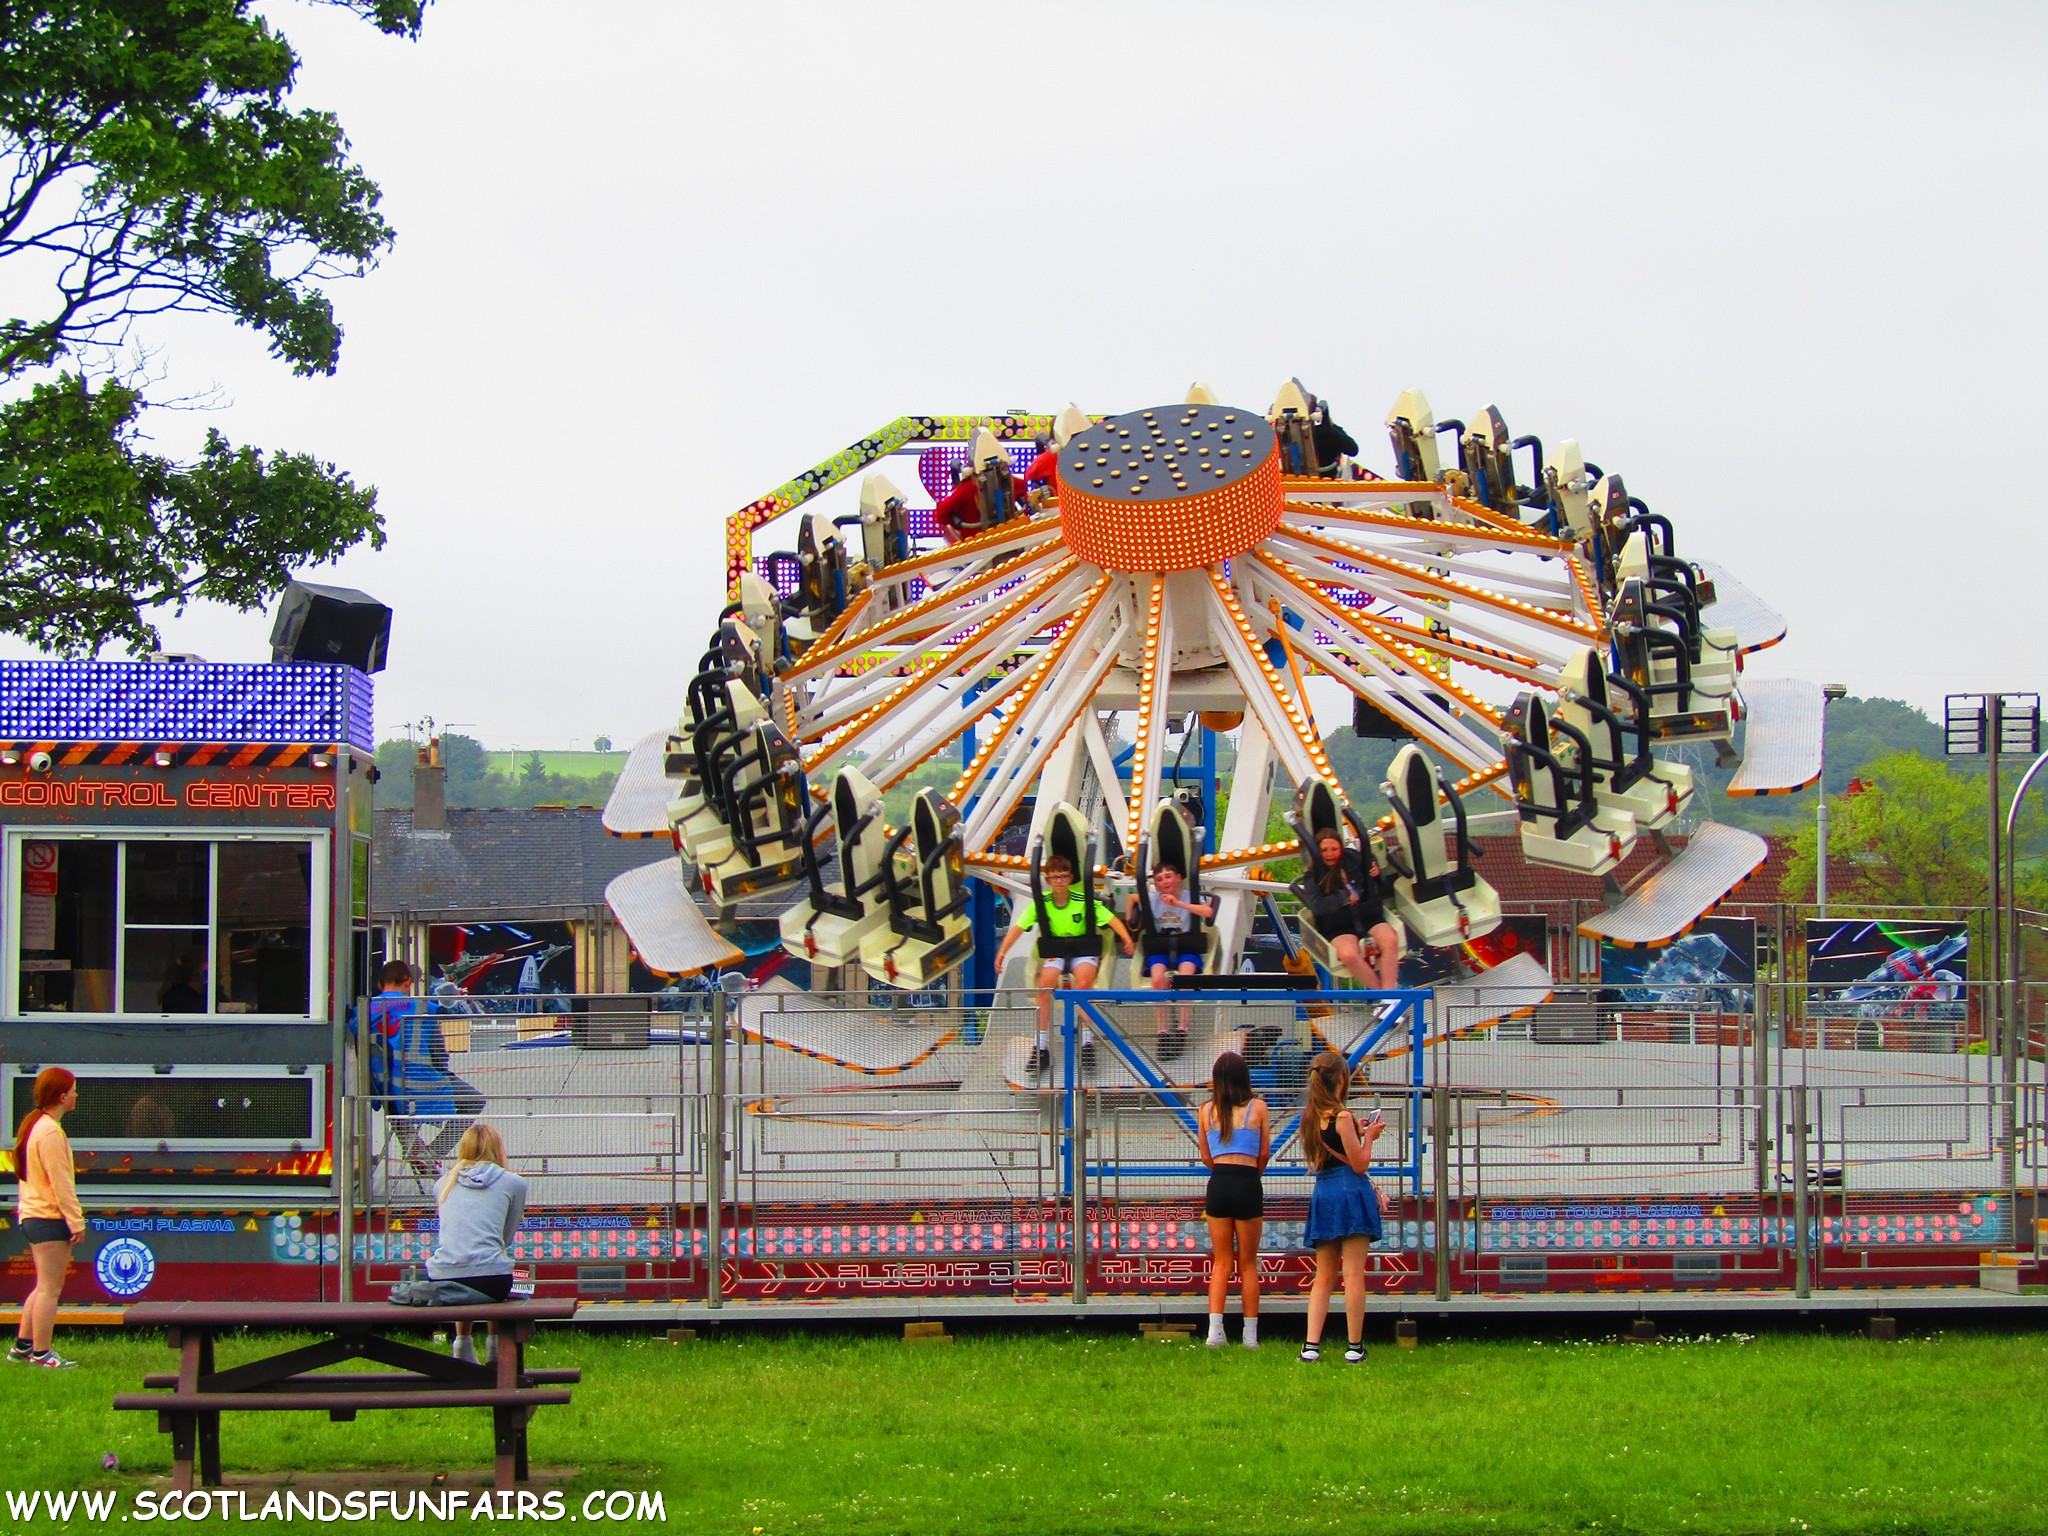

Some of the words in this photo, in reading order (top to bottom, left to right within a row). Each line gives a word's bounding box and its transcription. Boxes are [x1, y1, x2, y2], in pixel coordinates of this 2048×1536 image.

[1, 782, 177, 806] CONTROL
[186, 784, 335, 808] CENTER
[928, 1208, 1021, 1223] BEWARE
[1026, 1207, 1194, 1221] AFTRBURNERS
[1492, 1208, 1518, 1220] DO
[1521, 1207, 1558, 1220] NOT
[1564, 1206, 1622, 1219] TOUCH
[1625, 1205, 1701, 1218] PLASMA
[92, 1218, 153, 1231] TOUCH
[157, 1219, 235, 1232] PLASMA
[553, 1215, 632, 1228] PLASMA
[838, 1263, 980, 1288] FLIGHT
[1101, 1260, 1192, 1283] THIS
